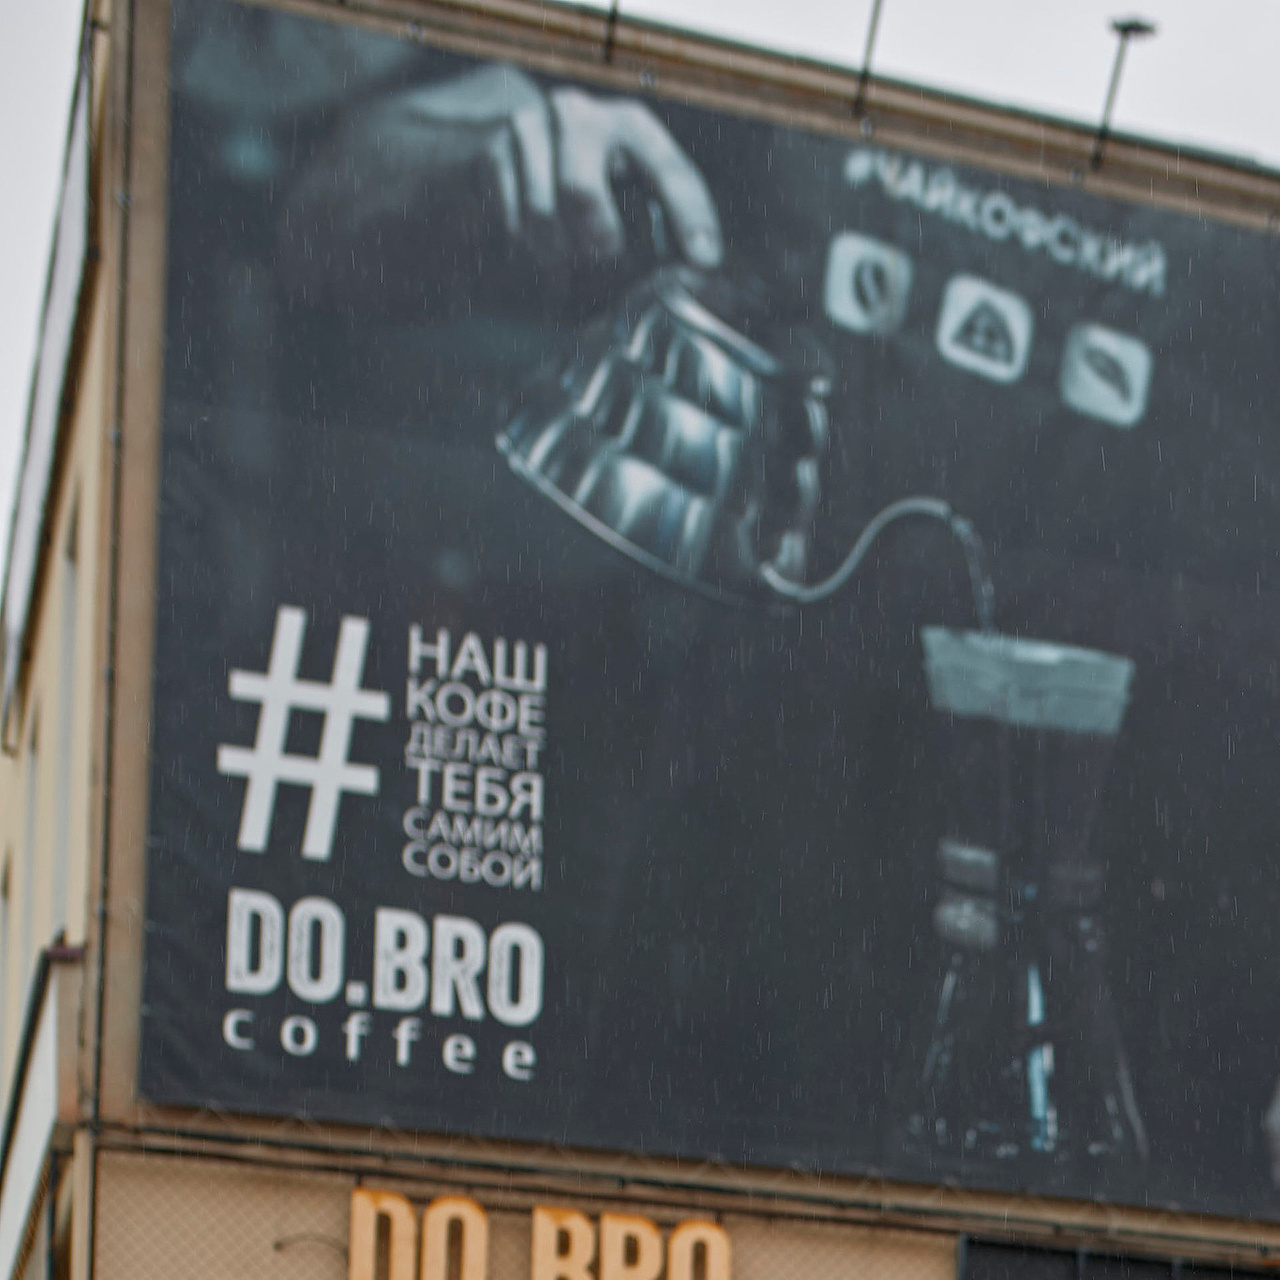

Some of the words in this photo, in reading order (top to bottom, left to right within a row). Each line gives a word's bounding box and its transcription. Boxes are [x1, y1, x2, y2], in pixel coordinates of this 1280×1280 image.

[407, 622, 548, 693] НАШ
[405, 677, 546, 737] КОФЕ
[404, 720, 541, 770] ДЕЛАЕТ
[405, 756, 545, 822] ТЕБЯ
[402, 805, 544, 857] САМИМ
[402, 838, 544, 892] СОБОЙ
[225, 888, 545, 1027] DO.BRO
[221, 1008, 538, 1081] coffee
